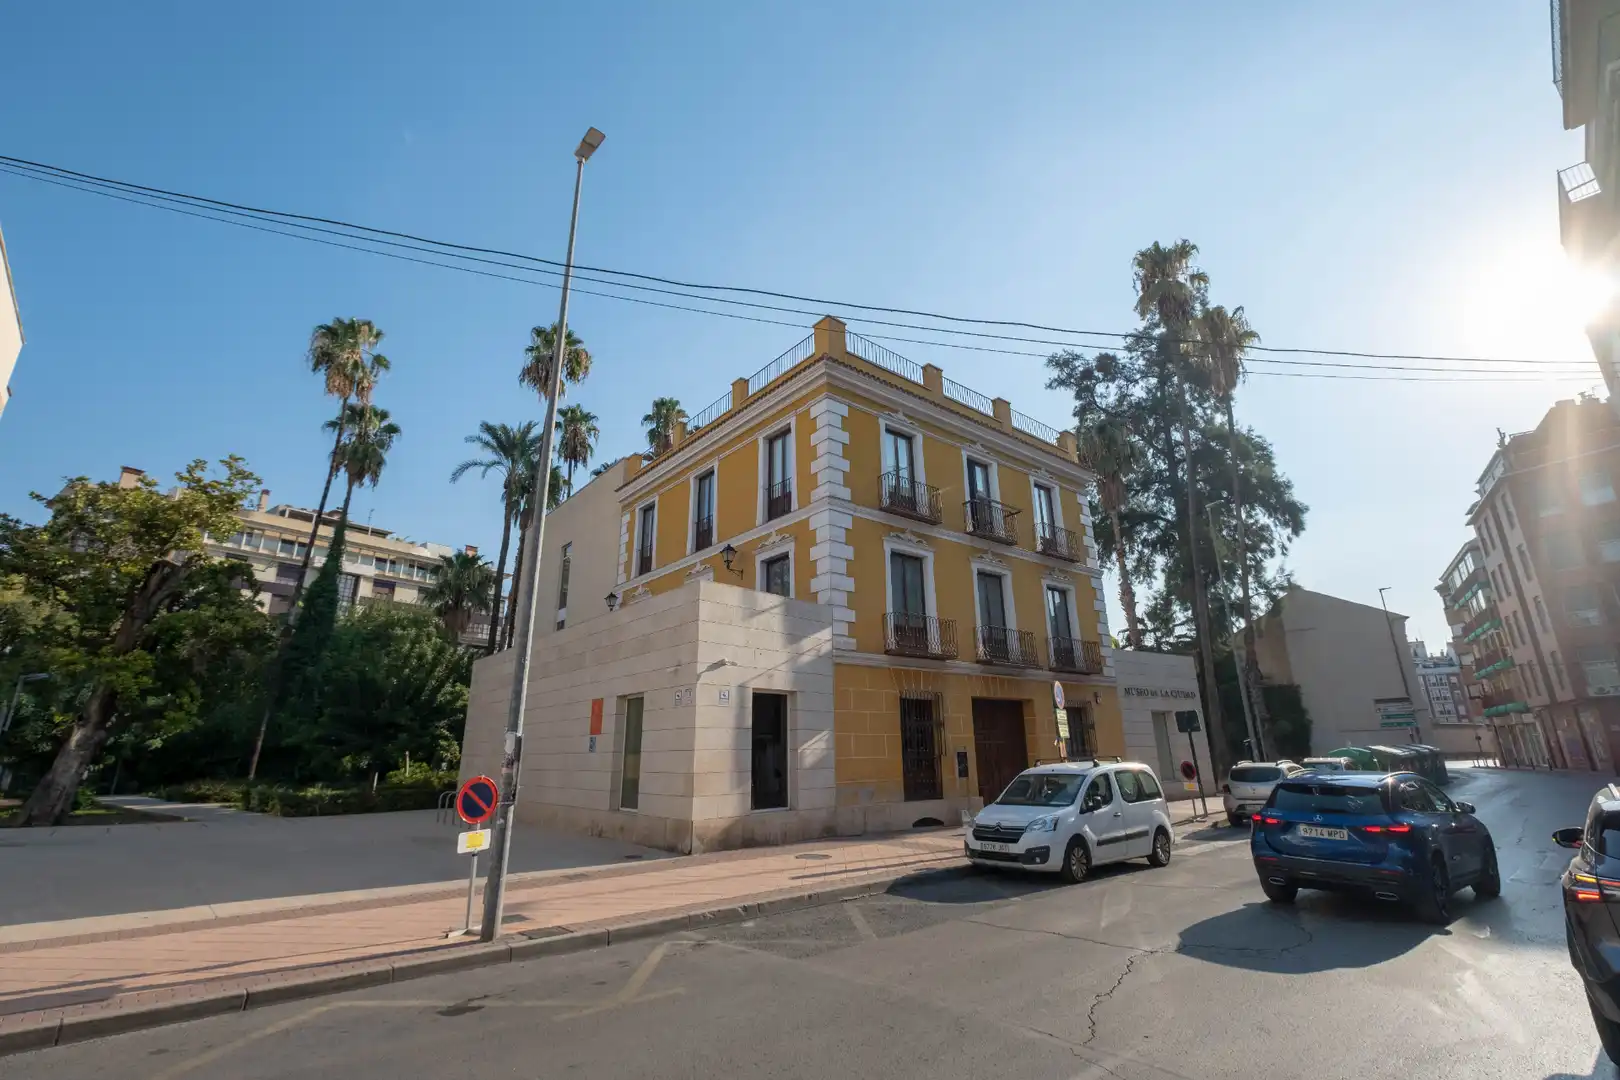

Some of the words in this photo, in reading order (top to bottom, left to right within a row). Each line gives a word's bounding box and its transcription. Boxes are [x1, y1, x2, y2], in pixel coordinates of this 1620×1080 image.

[1124, 687, 1149, 697] MUSEO
[1160, 689, 1169, 698] LA
[1303, 827, 1325, 837] 9714
[1328, 828, 1345, 839] MPD
